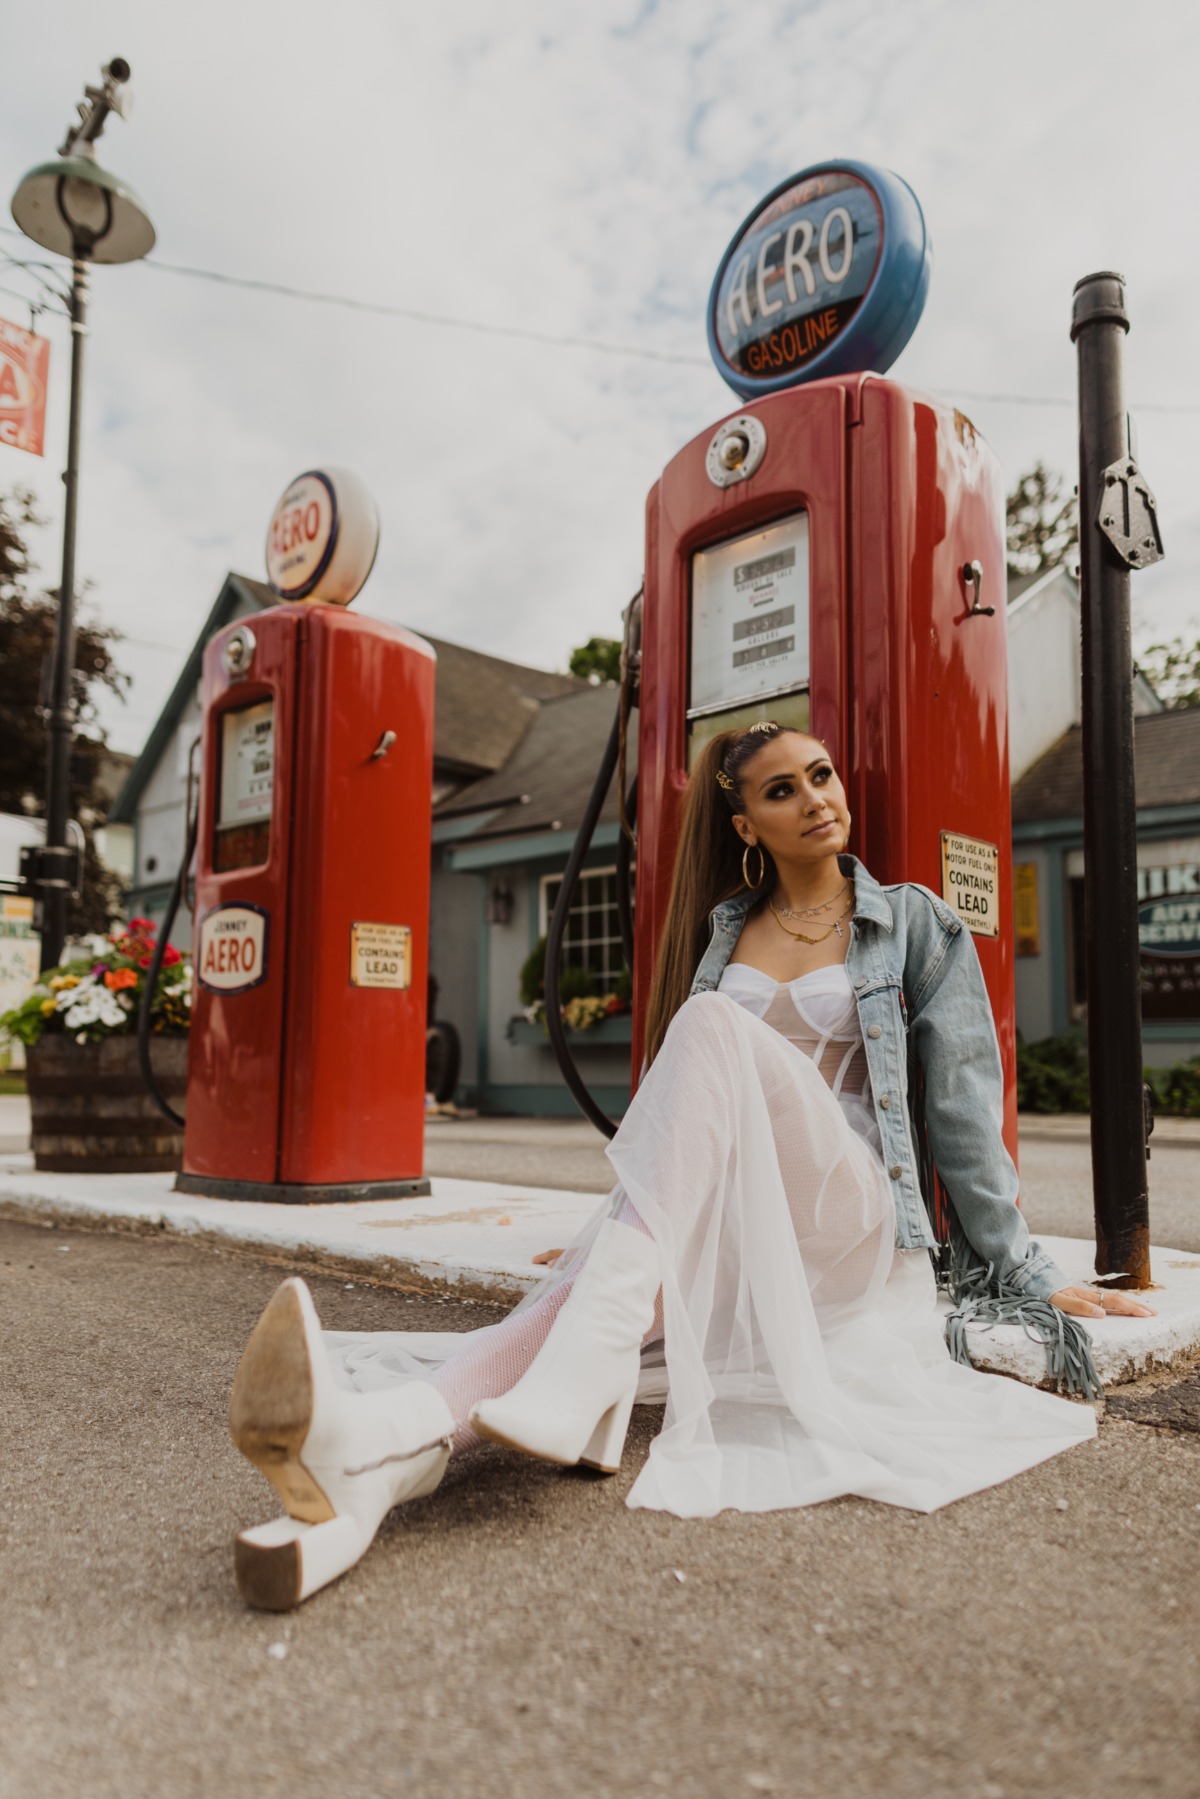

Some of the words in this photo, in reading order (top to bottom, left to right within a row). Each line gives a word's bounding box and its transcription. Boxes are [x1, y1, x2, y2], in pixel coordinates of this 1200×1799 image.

[726, 206, 854, 337] AERO
[747, 309, 840, 371] GASOLINE
[951, 840, 964, 852] FOR
[965, 844, 977, 855] USE
[978, 847, 986, 857] AS
[945, 852, 967, 865] MOTOR
[968, 858, 982, 870] FUEL
[984, 862, 997, 873] ONLY
[949, 870, 994, 894] CONTAINS
[957, 892, 988, 915] LEAD
[959, 915, 991, 930] ETRAETHYL)
[205, 936, 256, 974] AERO
[358, 947, 404, 960] CONTAINS
[365, 961, 398, 974] LEAD
